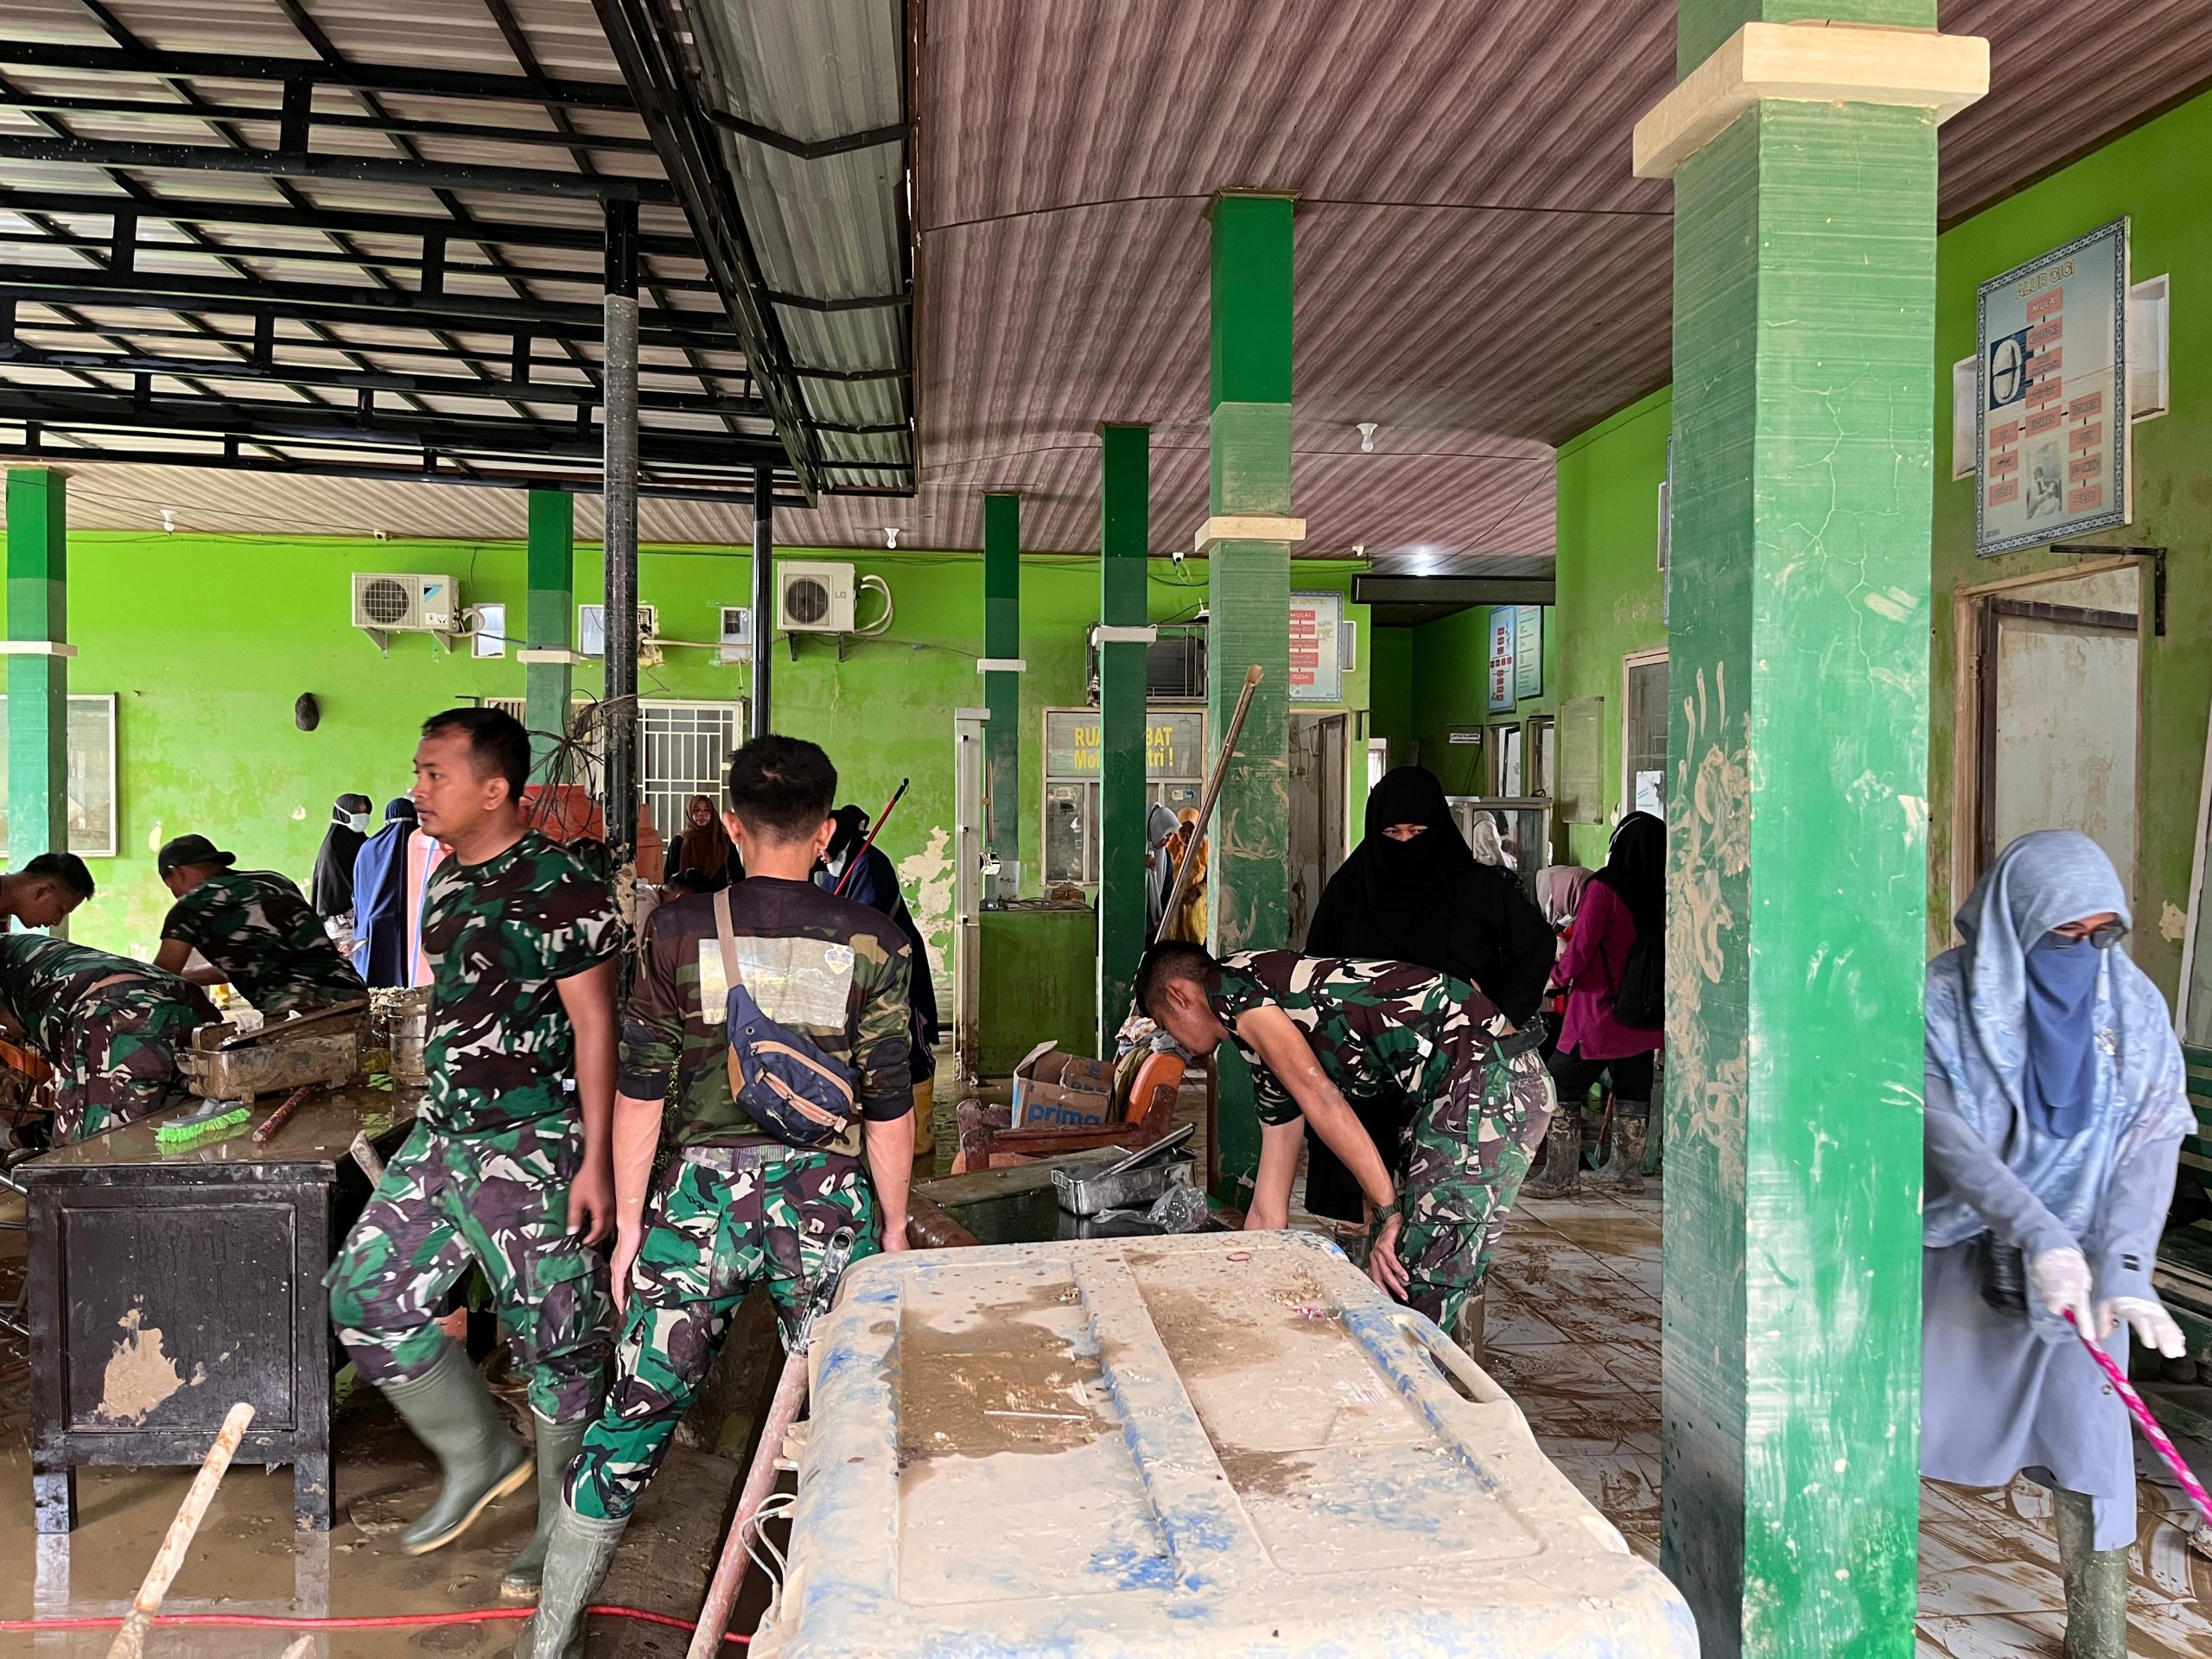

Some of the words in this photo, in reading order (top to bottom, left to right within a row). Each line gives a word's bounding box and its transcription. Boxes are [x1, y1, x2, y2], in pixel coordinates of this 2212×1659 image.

[2016, 274, 2048, 297] ALUR
[2050, 259, 2075, 283] GIGI
[2031, 296, 2059, 314] MULAI
